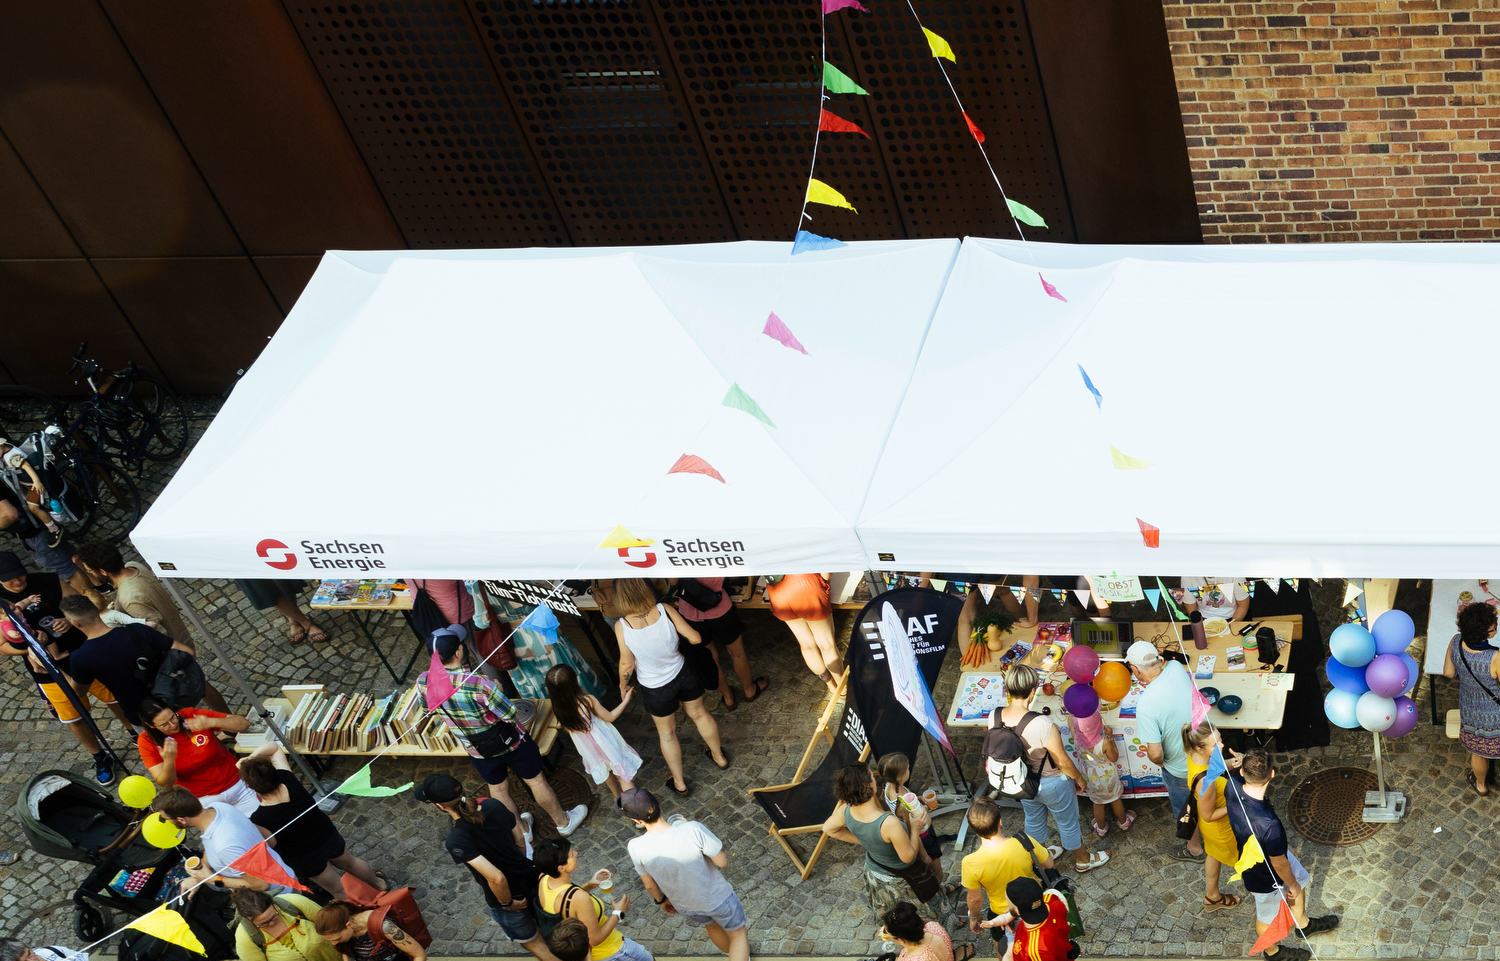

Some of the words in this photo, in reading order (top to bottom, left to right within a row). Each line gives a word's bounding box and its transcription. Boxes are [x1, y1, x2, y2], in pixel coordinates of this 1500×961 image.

[300, 540, 385, 554] Sachsen
[662, 538, 745, 553] Sachsen
[308, 556, 387, 572] Energie
[668, 554, 745, 569] Energie
[1107, 579, 1135, 590] OBST
